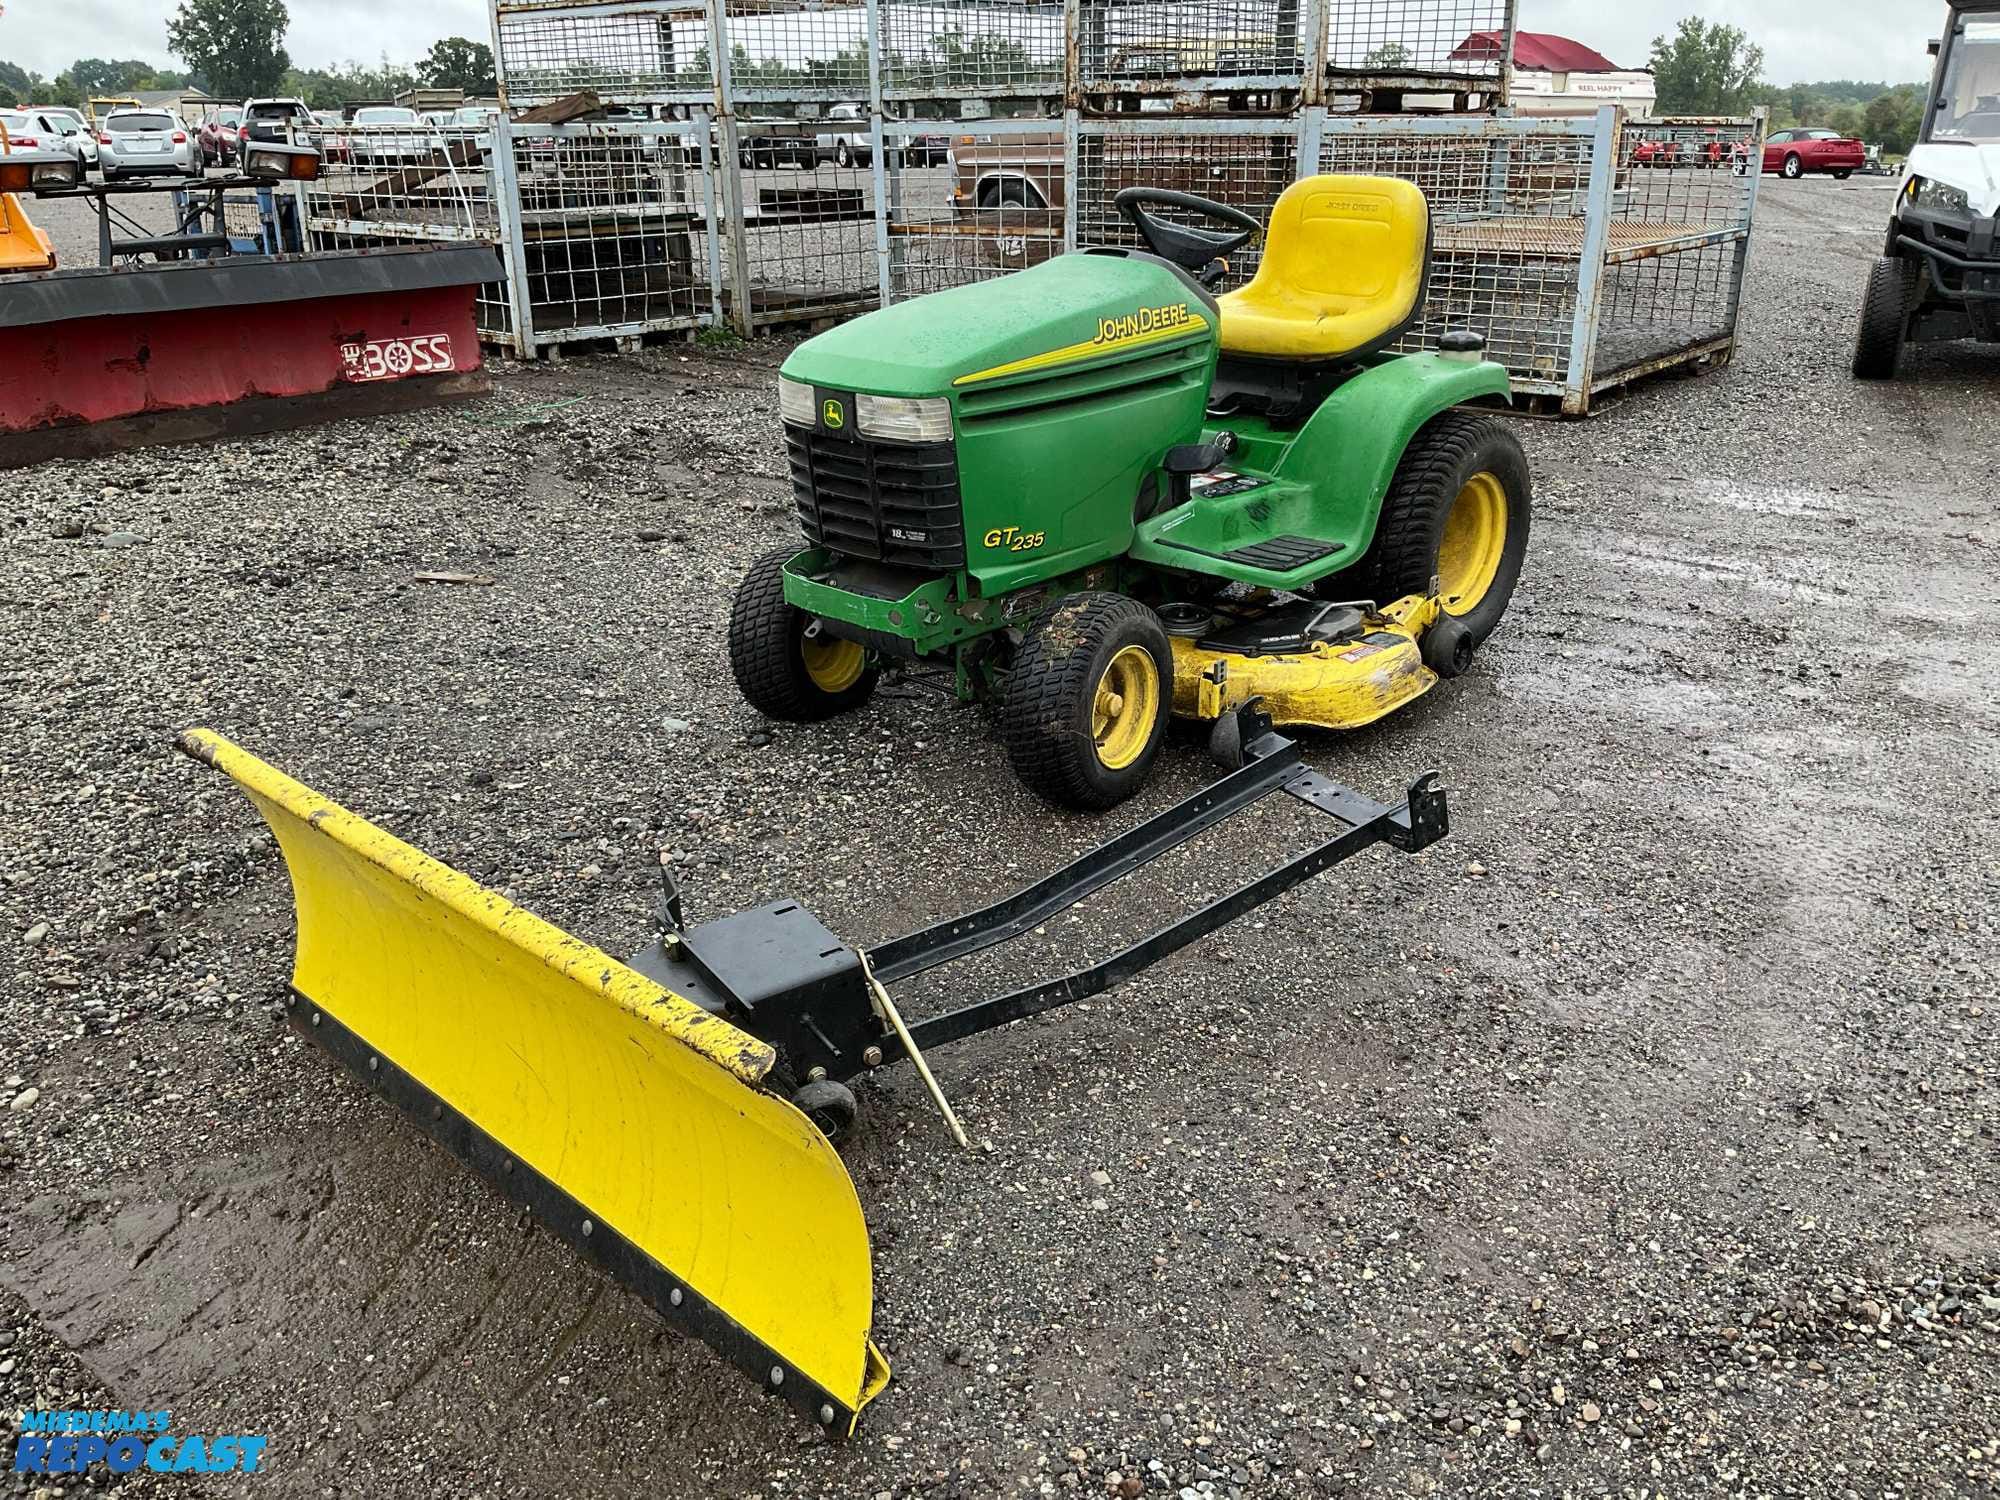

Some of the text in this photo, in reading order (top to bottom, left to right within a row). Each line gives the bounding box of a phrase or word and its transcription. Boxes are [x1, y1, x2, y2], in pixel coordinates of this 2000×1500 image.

[1094, 303, 1189, 344] JOHN DEERE
[363, 336, 451, 377] BOSS
